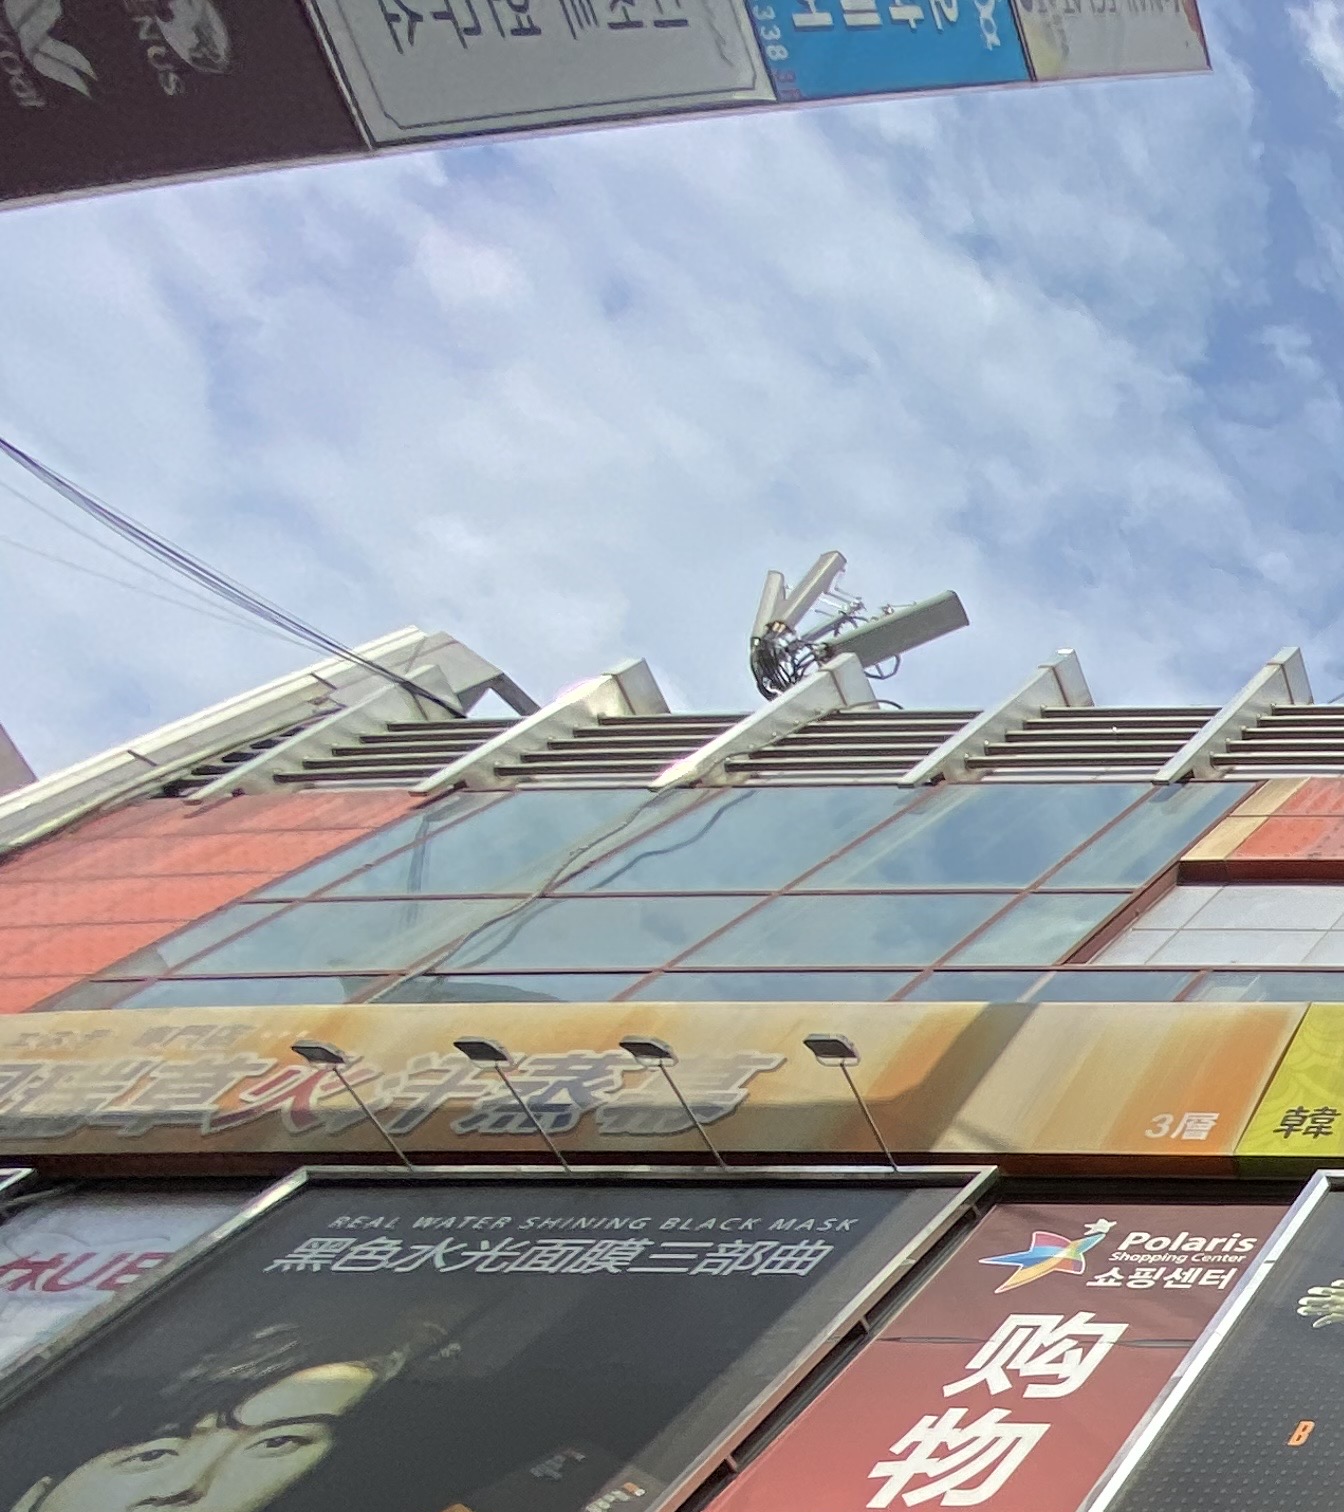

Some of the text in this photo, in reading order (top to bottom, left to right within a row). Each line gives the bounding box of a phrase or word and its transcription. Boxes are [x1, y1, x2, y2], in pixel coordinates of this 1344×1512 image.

[1144, 1111, 1220, 1141] 3層
[327, 1216, 860, 1233] REAL WATER SHINING BLACK MASK
[1117, 1231, 1258, 1253] Polaris
[1108, 1252, 1248, 1264] Shopping Center
[1086, 1266, 1238, 1290] 쇼핑센터
